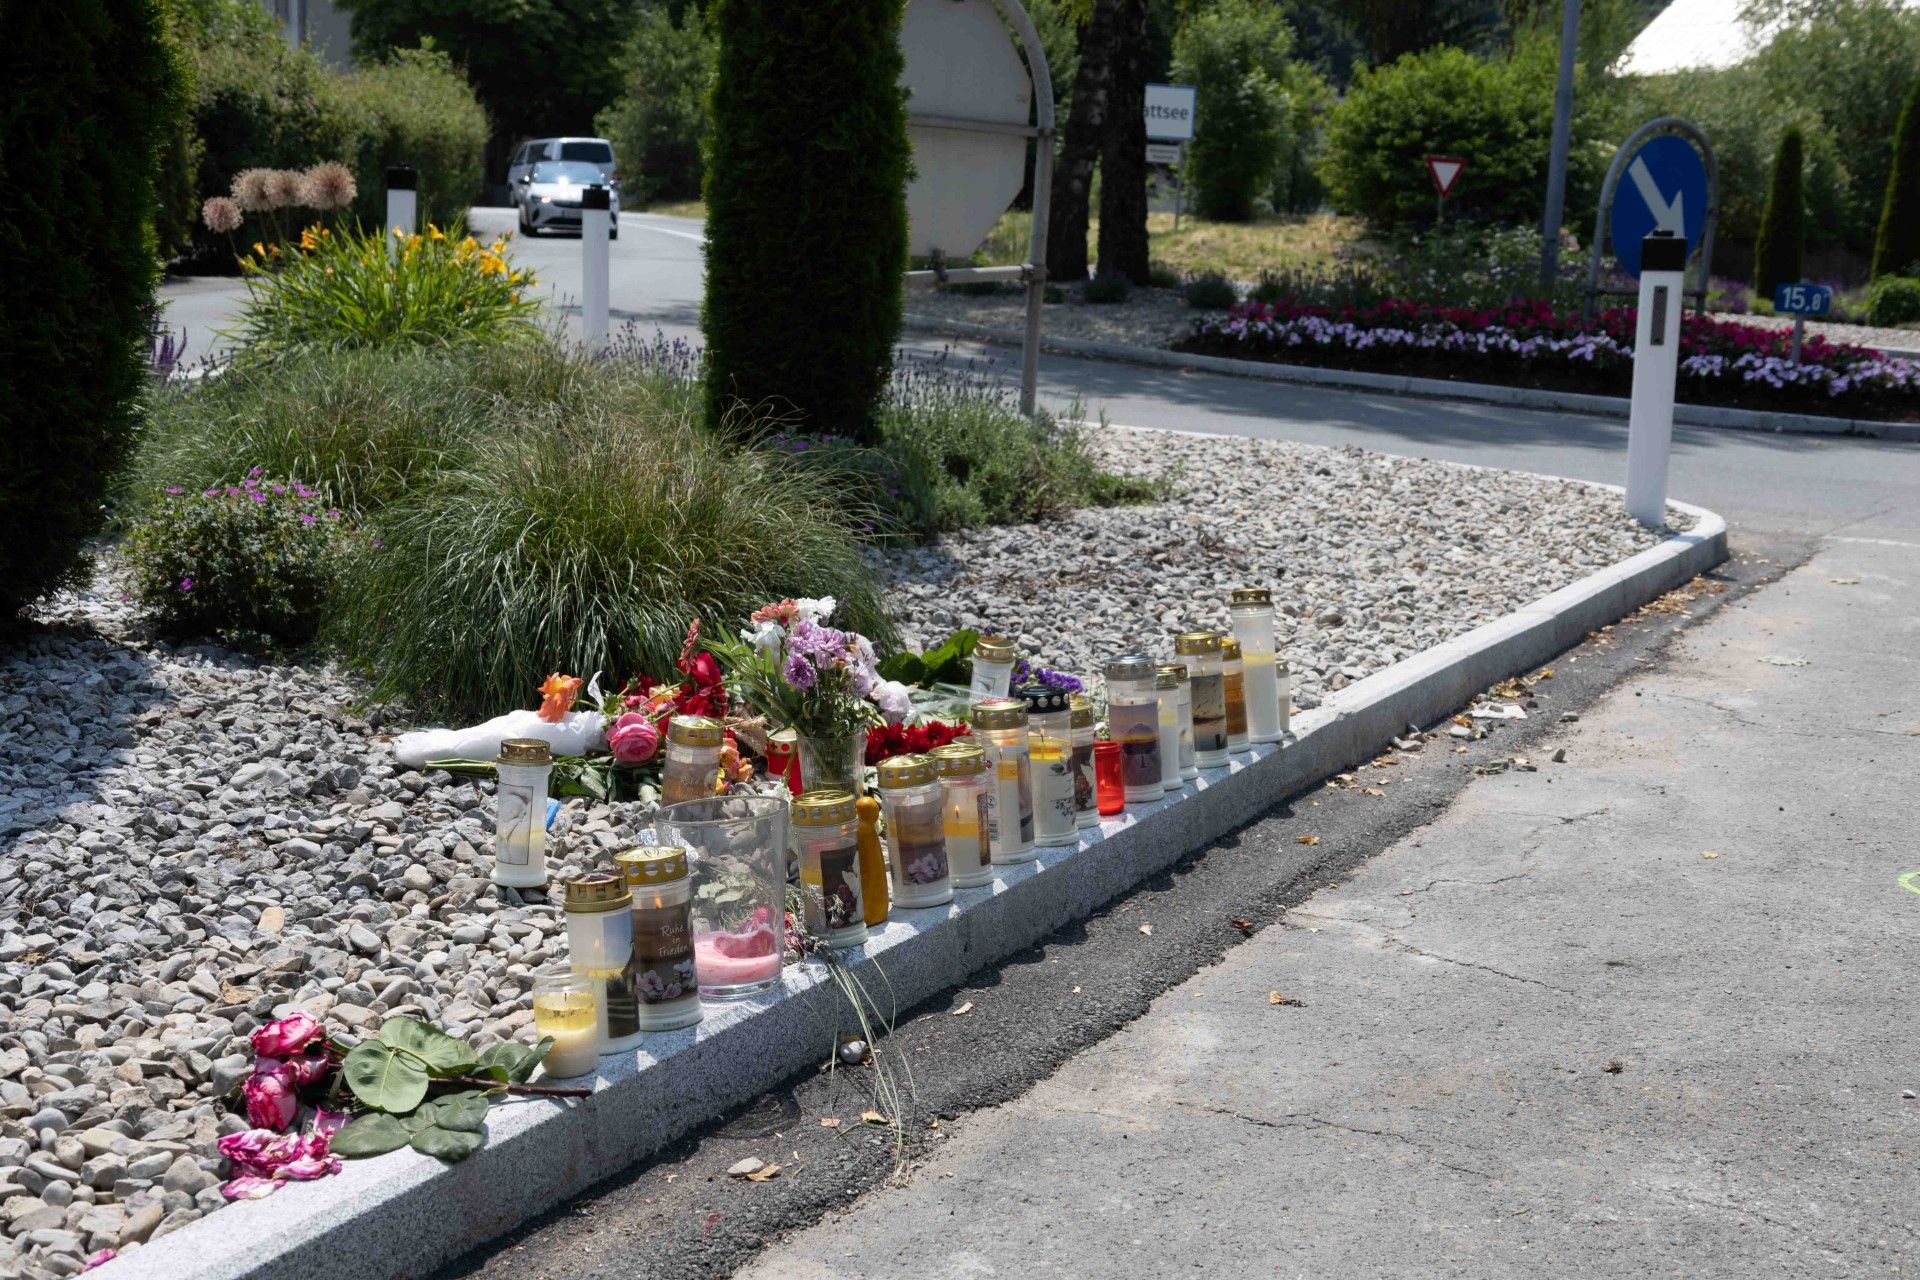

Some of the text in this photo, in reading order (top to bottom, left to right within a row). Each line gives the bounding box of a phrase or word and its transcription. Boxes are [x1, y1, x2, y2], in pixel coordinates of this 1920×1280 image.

[660, 924, 684, 937] Ruhe
[672, 935, 681, 944] in
[658, 944, 688, 957] Frieden
